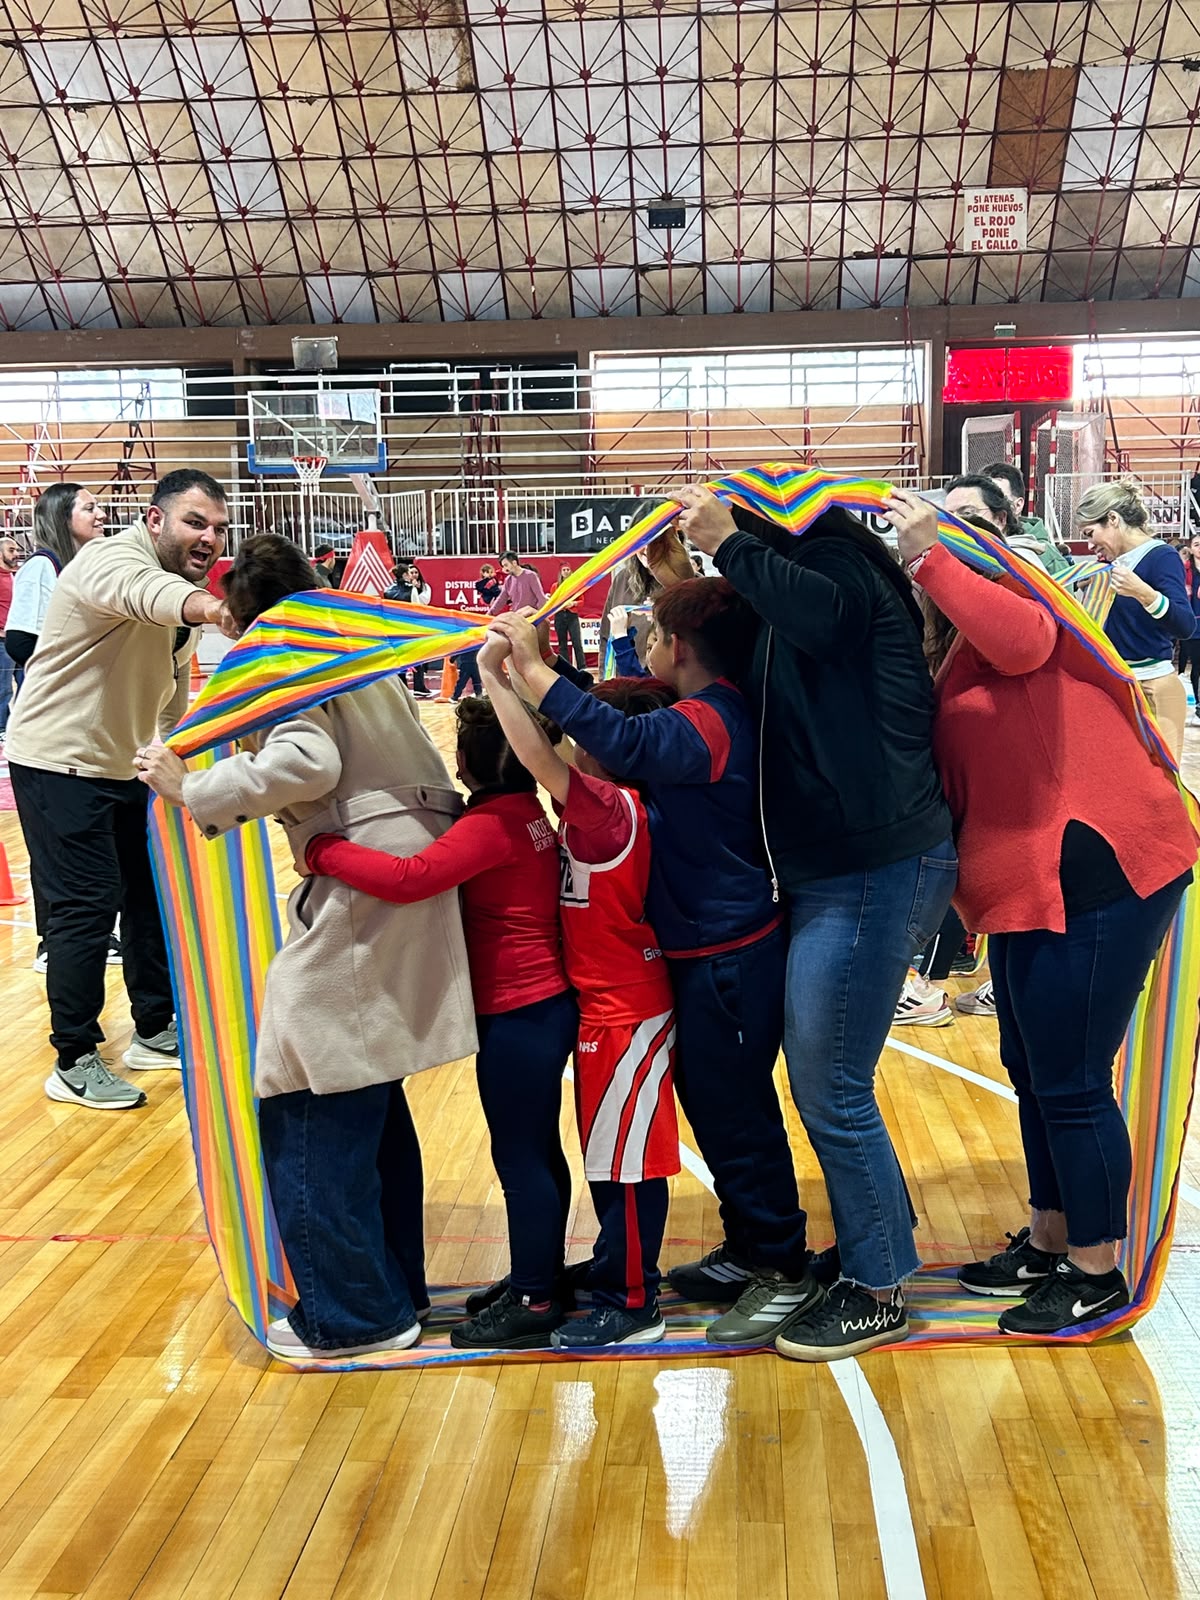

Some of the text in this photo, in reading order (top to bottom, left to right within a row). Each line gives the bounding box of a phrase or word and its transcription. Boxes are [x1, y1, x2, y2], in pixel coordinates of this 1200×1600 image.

[974, 194, 1015, 204] SI ATENAS
[967, 204, 990, 213] PONE
[974, 215, 1016, 226] EL ROJO
[982, 227, 1010, 238] PONE
[971, 239, 1018, 250] EL GALLO
[445, 590, 468, 605] LA
